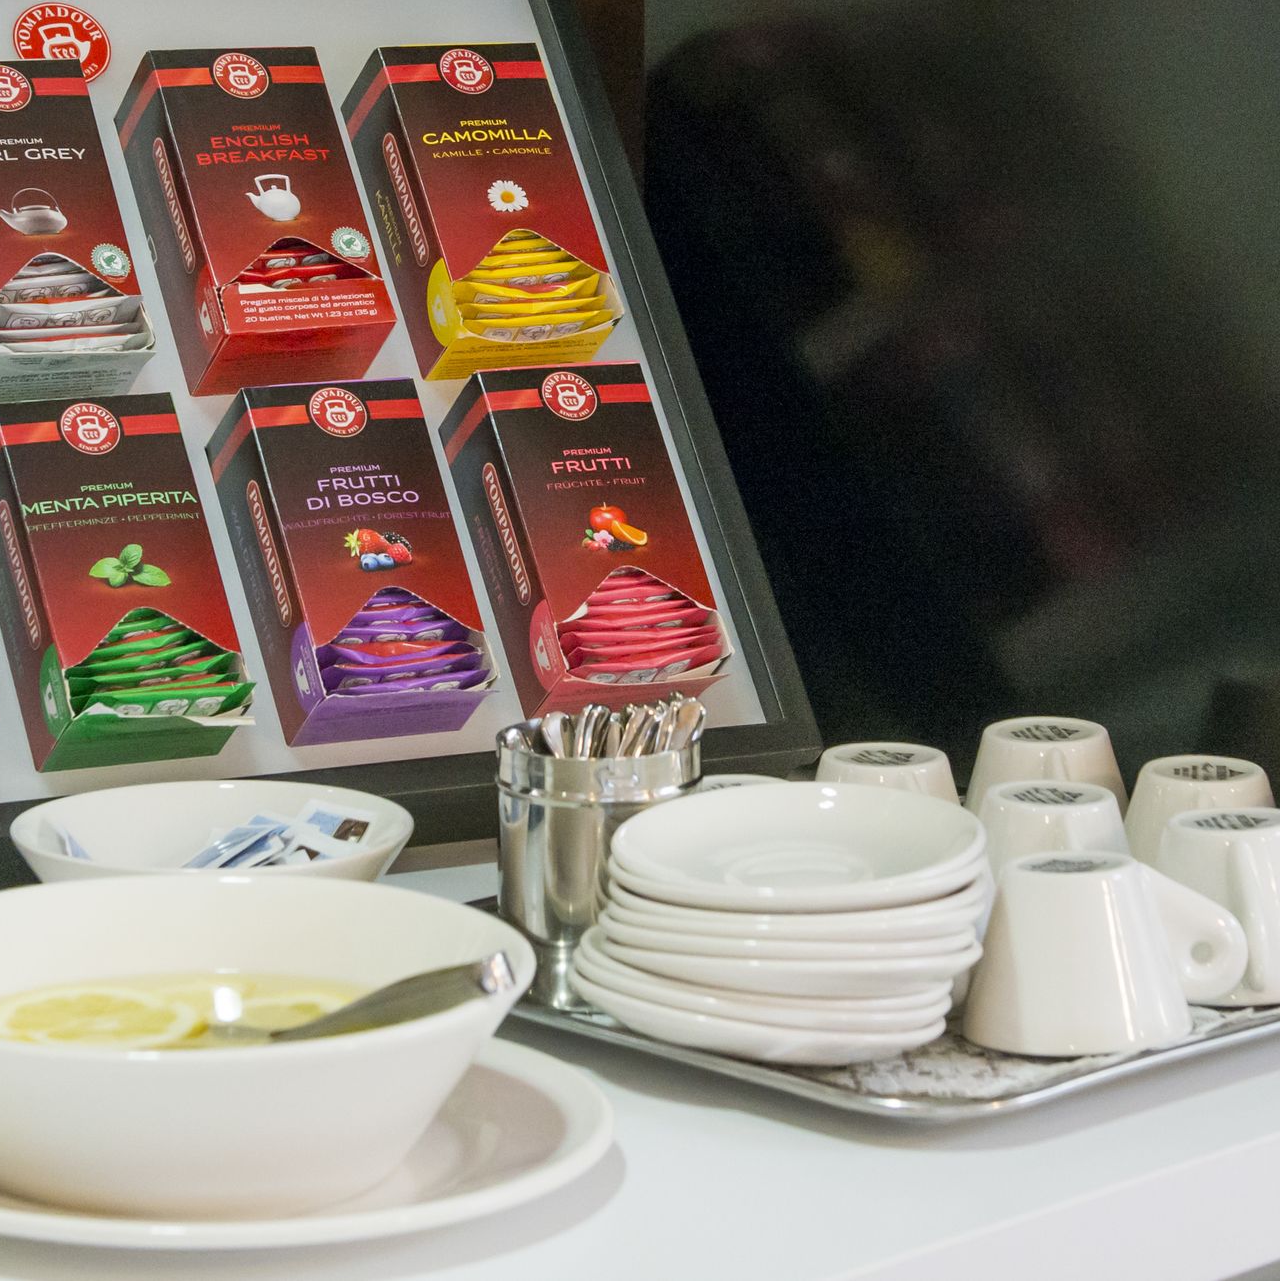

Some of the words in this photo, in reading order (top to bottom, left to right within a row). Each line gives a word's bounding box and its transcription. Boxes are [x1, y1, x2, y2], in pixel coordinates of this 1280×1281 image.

[18, 6, 103, 51] POMPADOUR
[216, 55, 265, 77] POMPADOUR
[442, 50, 490, 74] POMPADOUR
[460, 119, 508, 127] PREMIUM
[210, 133, 310, 149] ENGLISH
[422, 128, 552, 145] CAMOMILLA
[24, 148, 86, 160] GREY
[193, 149, 330, 166] BREAKFAST
[433, 149, 484, 159] KAMILLE
[493, 147, 552, 155] CAMOMILE
[155, 145, 194, 268] POMPADOUR
[385, 140, 427, 261] POMPADOUR
[375, 189, 403, 267] KAMILLE
[331, 292, 375, 301] selezionati
[258, 306, 283, 314] gusto
[284, 303, 319, 311] corposo
[332, 300, 375, 308] aromatico
[545, 374, 593, 398] POMPADOUR
[312, 389, 364, 415] POMPADOUR
[64, 405, 117, 432] POMPADOUR
[563, 448, 612, 457] PREMIUM
[330, 464, 381, 474] PREMIUM
[551, 458, 632, 474] FRUTTI
[80, 482, 133, 493] PREMIUM
[317, 475, 401, 492] FRUTTI
[613, 477, 646, 486] FRUIT
[21, 497, 100, 516] MENTA
[102, 491, 197, 507] PIPERITA
[306, 496, 331, 511] DI
[337, 490, 420, 507] BOSCO
[27, 516, 118, 534] PFEFFERMINZE
[127, 512, 201, 522] PEPPERMINT
[377, 511, 418, 520] FOREST
[421, 511, 451, 519] FRUIT
[485, 471, 529, 600] POMPADOUR
[249, 489, 290, 622] POMPADOUR
[0, 509, 40, 644] POMPADOUR
